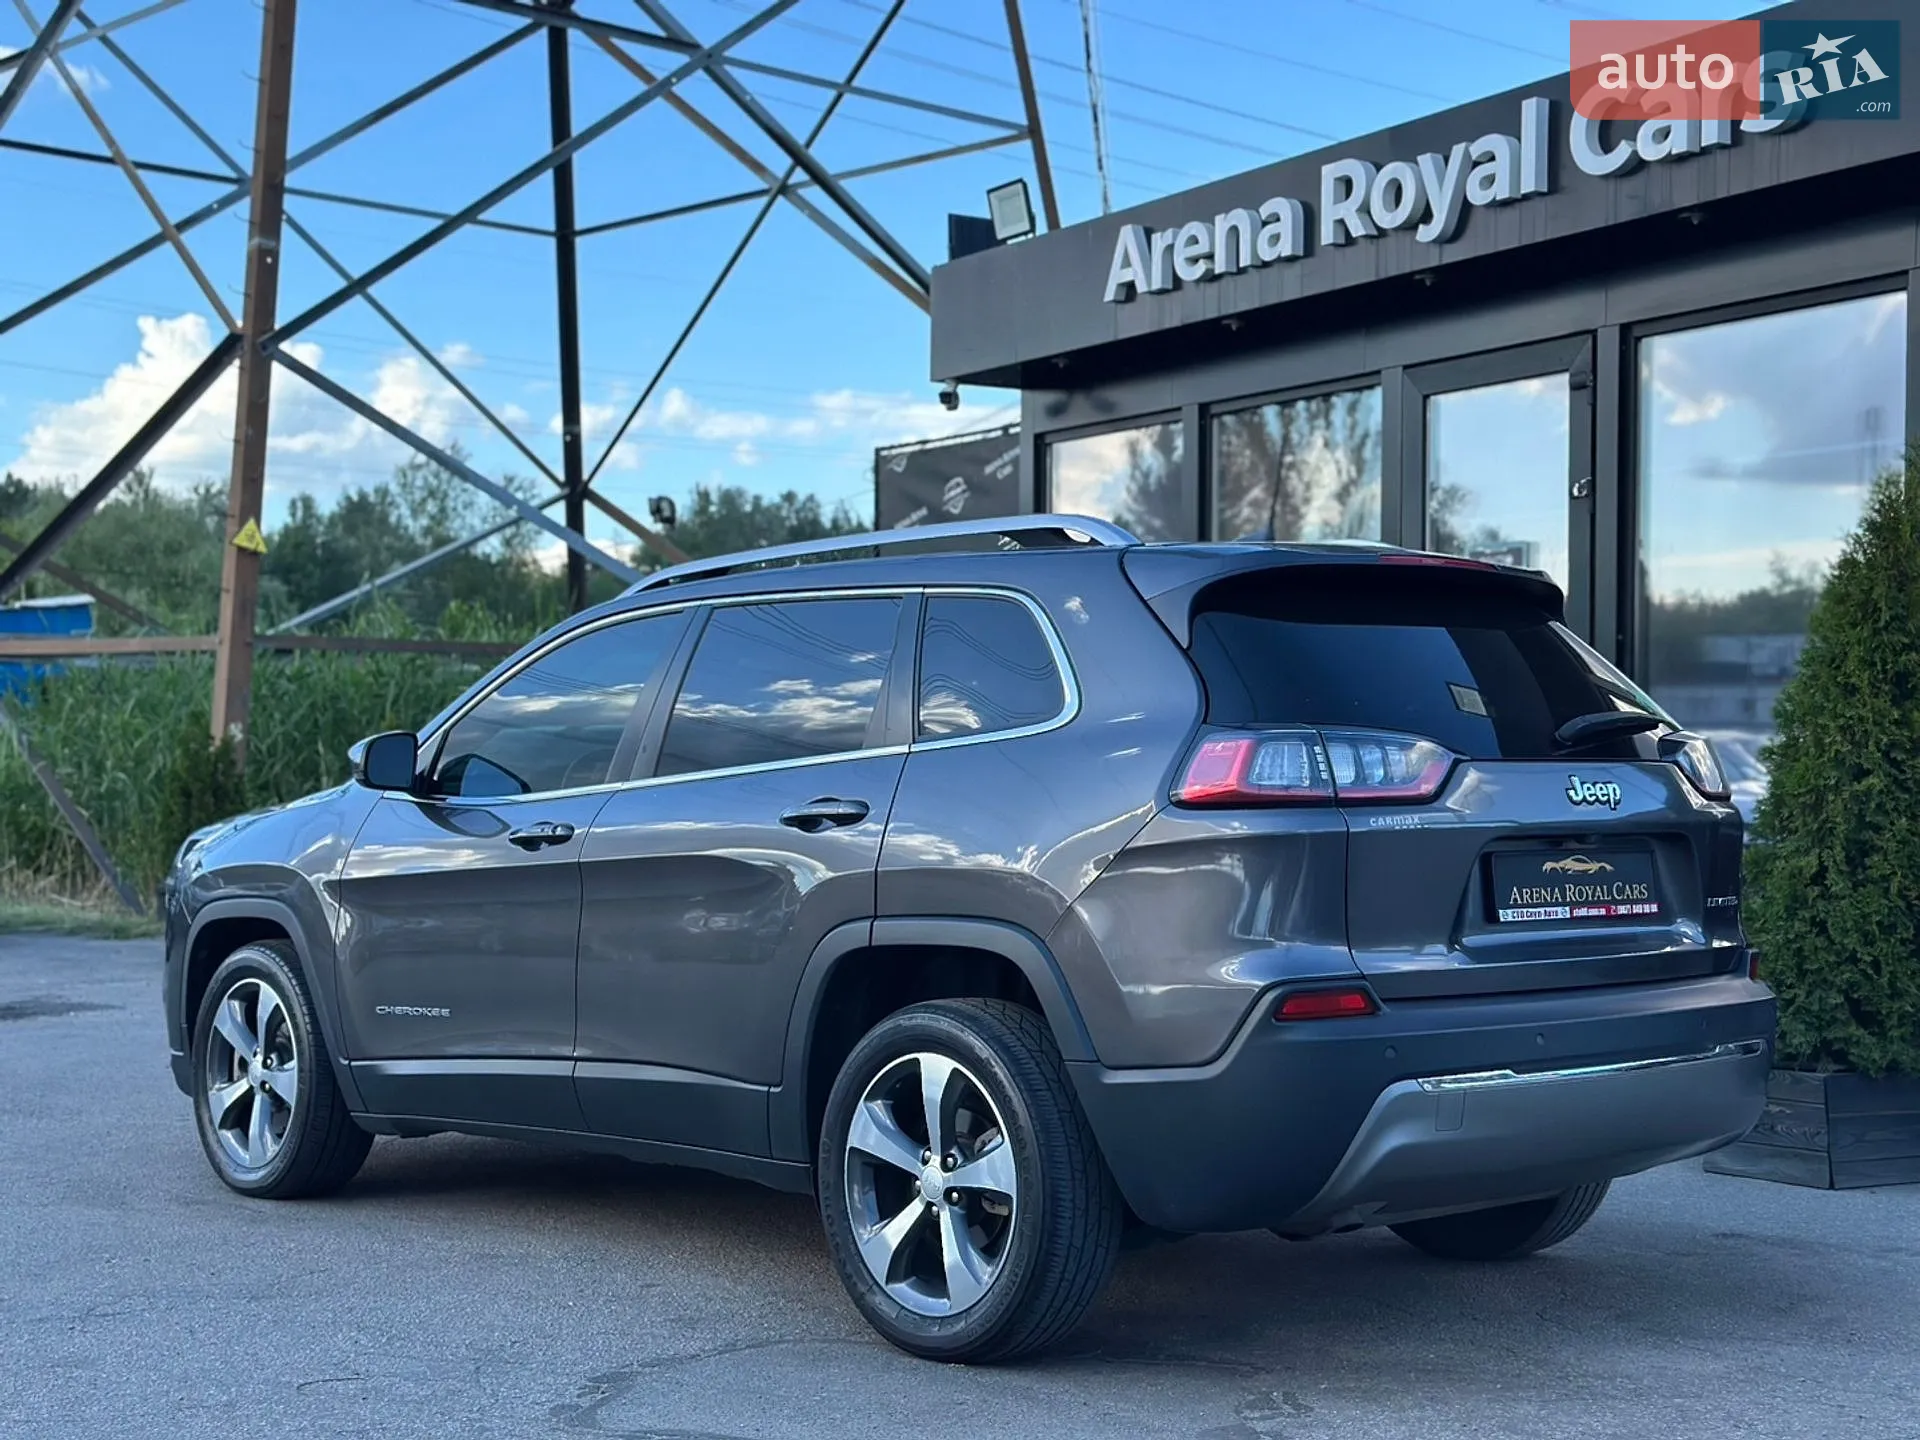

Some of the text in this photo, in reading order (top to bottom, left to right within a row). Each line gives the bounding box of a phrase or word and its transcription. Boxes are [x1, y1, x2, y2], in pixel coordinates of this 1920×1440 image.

[1103, 51, 1806, 302] Arena Royal Cars
[1565, 774, 1622, 810] Jeep
[375, 1006, 451, 1017] CHEROKEE
